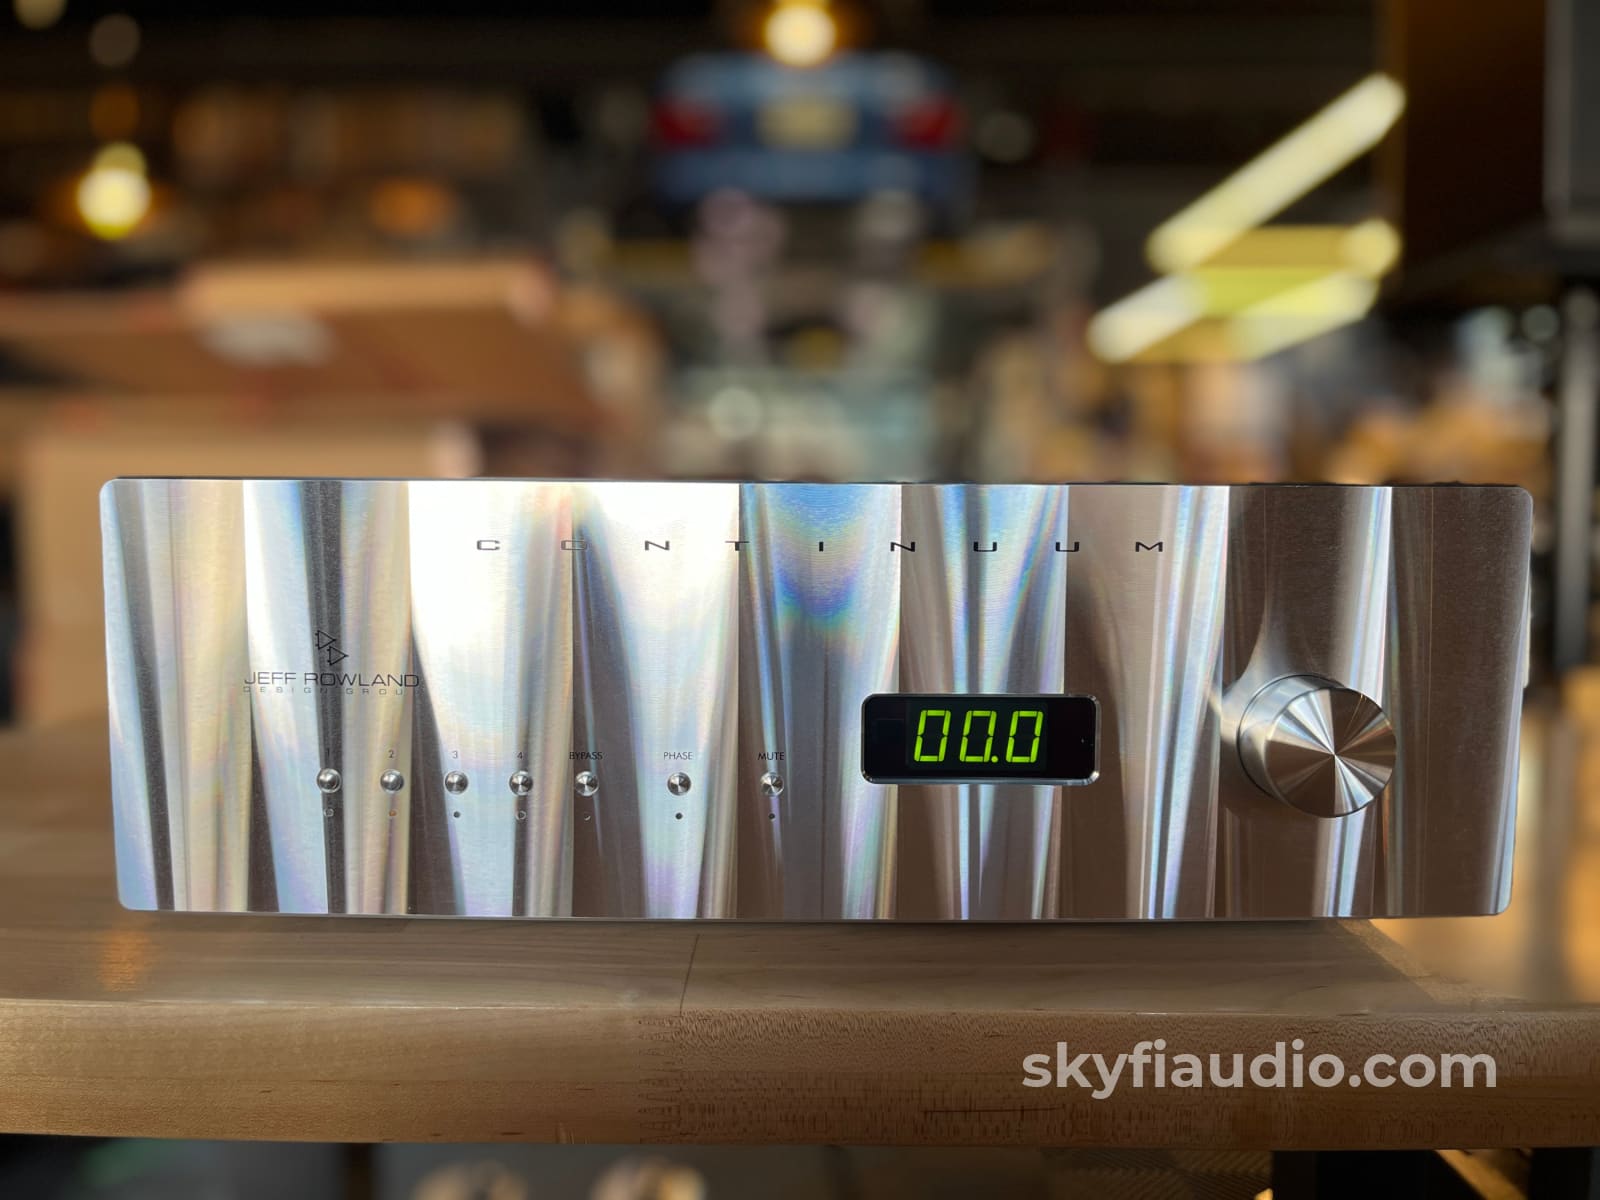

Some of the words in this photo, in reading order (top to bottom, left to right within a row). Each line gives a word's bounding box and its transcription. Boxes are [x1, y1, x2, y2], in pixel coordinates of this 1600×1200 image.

[476, 539, 1164, 553] CONTINUUM
[244, 671, 296, 685] JEFF
[303, 672, 420, 687] ROWLAND
[914, 709, 1044, 763] 00.0
[388, 750, 394, 759] 2
[452, 751, 459, 760] 3
[517, 752, 524, 760] 4
[569, 752, 603, 760] BYPASS
[663, 752, 693, 760] PHASE
[757, 752, 785, 760] MUTE
